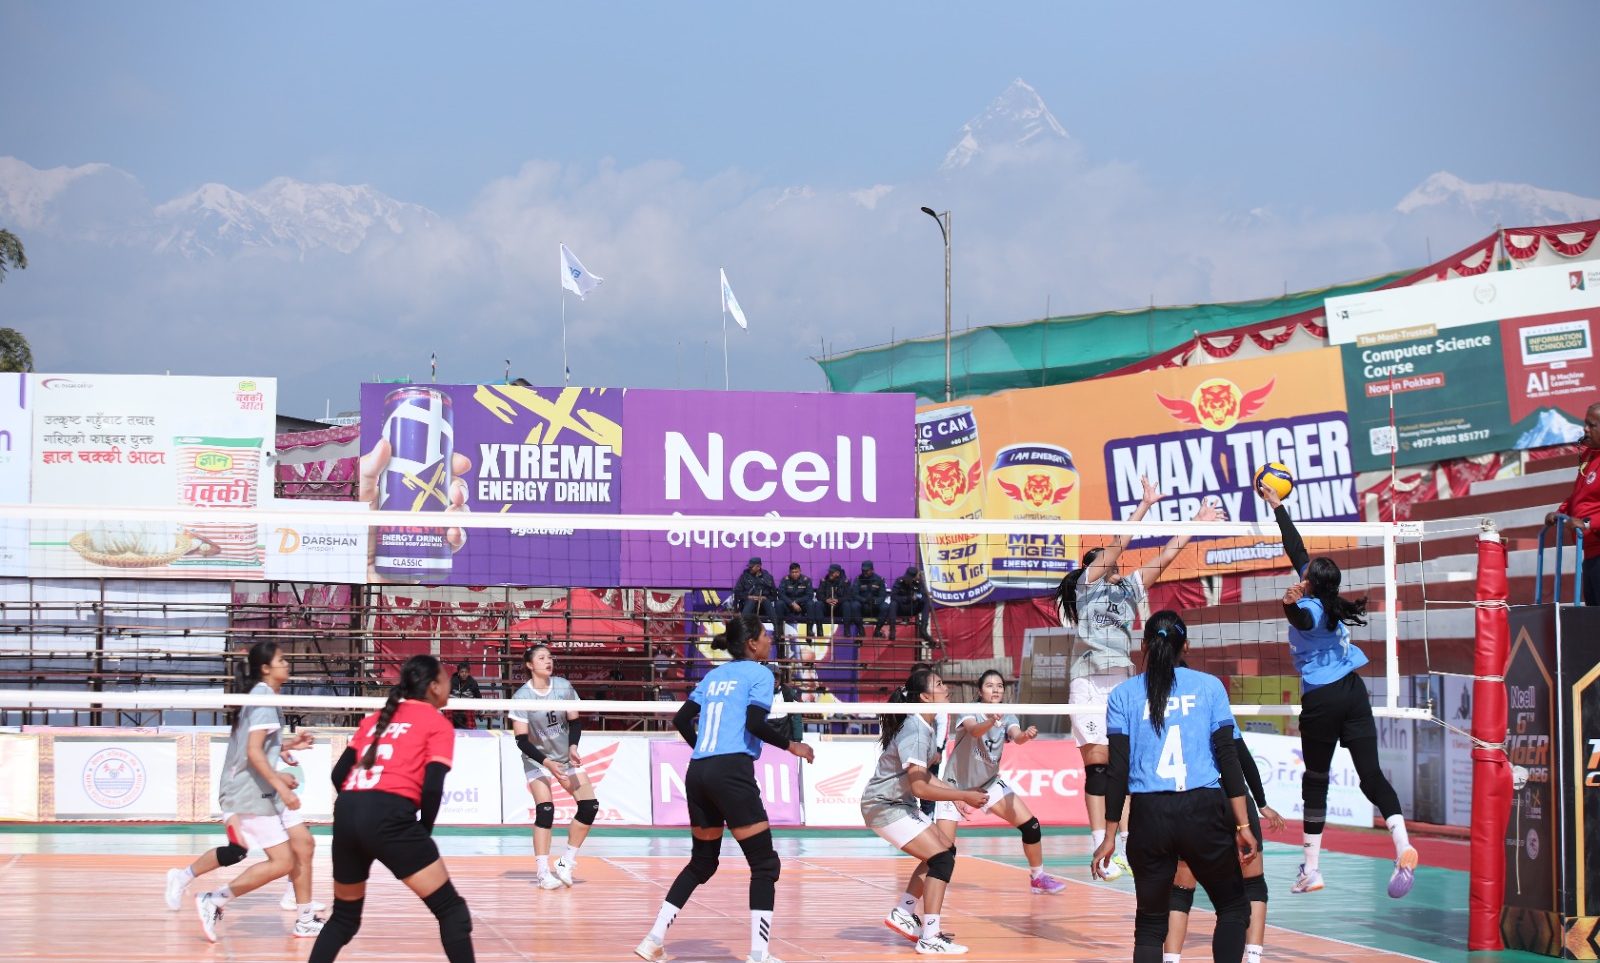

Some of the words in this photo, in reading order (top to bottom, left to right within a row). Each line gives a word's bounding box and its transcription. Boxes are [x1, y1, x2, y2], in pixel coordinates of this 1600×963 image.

[1528, 332, 1582, 345] INFORMATION
[1530, 340, 1582, 352] TECHNOLOGY
[1362, 343, 1433, 363] Computer
[1435, 335, 1491, 353] Science
[1364, 362, 1414, 379] Course
[1368, 384, 1391, 394] Now
[1392, 381, 1401, 390] in
[1402, 376, 1441, 389] Pokhara
[1526, 370, 1549, 393] AI
[937, 416, 969, 435] CAN
[1458, 429, 1490, 443] 851717
[42, 450, 73, 464] ज्ञान
[78, 446, 122, 464] चक्की
[127, 450, 166, 464] आटा
[479, 443, 613, 481] XTREME
[1112, 436, 1220, 502] MAX
[1226, 420, 1352, 488] TIGER
[664, 431, 877, 503] Ncell
[478, 480, 549, 501] ENERGY
[554, 481, 611, 502] DRINK
[302, 535, 357, 546] DARSHAN
[382, 534, 414, 542] ENERGY
[416, 535, 443, 543] DRINK
[937, 543, 978, 561] 330
[1007, 545, 1065, 558] TIGER
[392, 558, 423, 567] CLASSIC
[1003, 559, 1040, 568] ENERGY
[932, 590, 965, 600] ENERGY
[705, 680, 738, 696] APF
[1511, 685, 1536, 709] Ncell
[546, 710, 557, 725] 16
[699, 701, 724, 753] 11
[1156, 725, 1188, 792] 4
[1505, 734, 1550, 765] TIGER
[660, 762, 791, 803] Nll
[1004, 768, 1079, 797] KFC
[1529, 767, 1548, 783] 026
[440, 787, 479, 806] yoti
[815, 796, 862, 805] HOND
